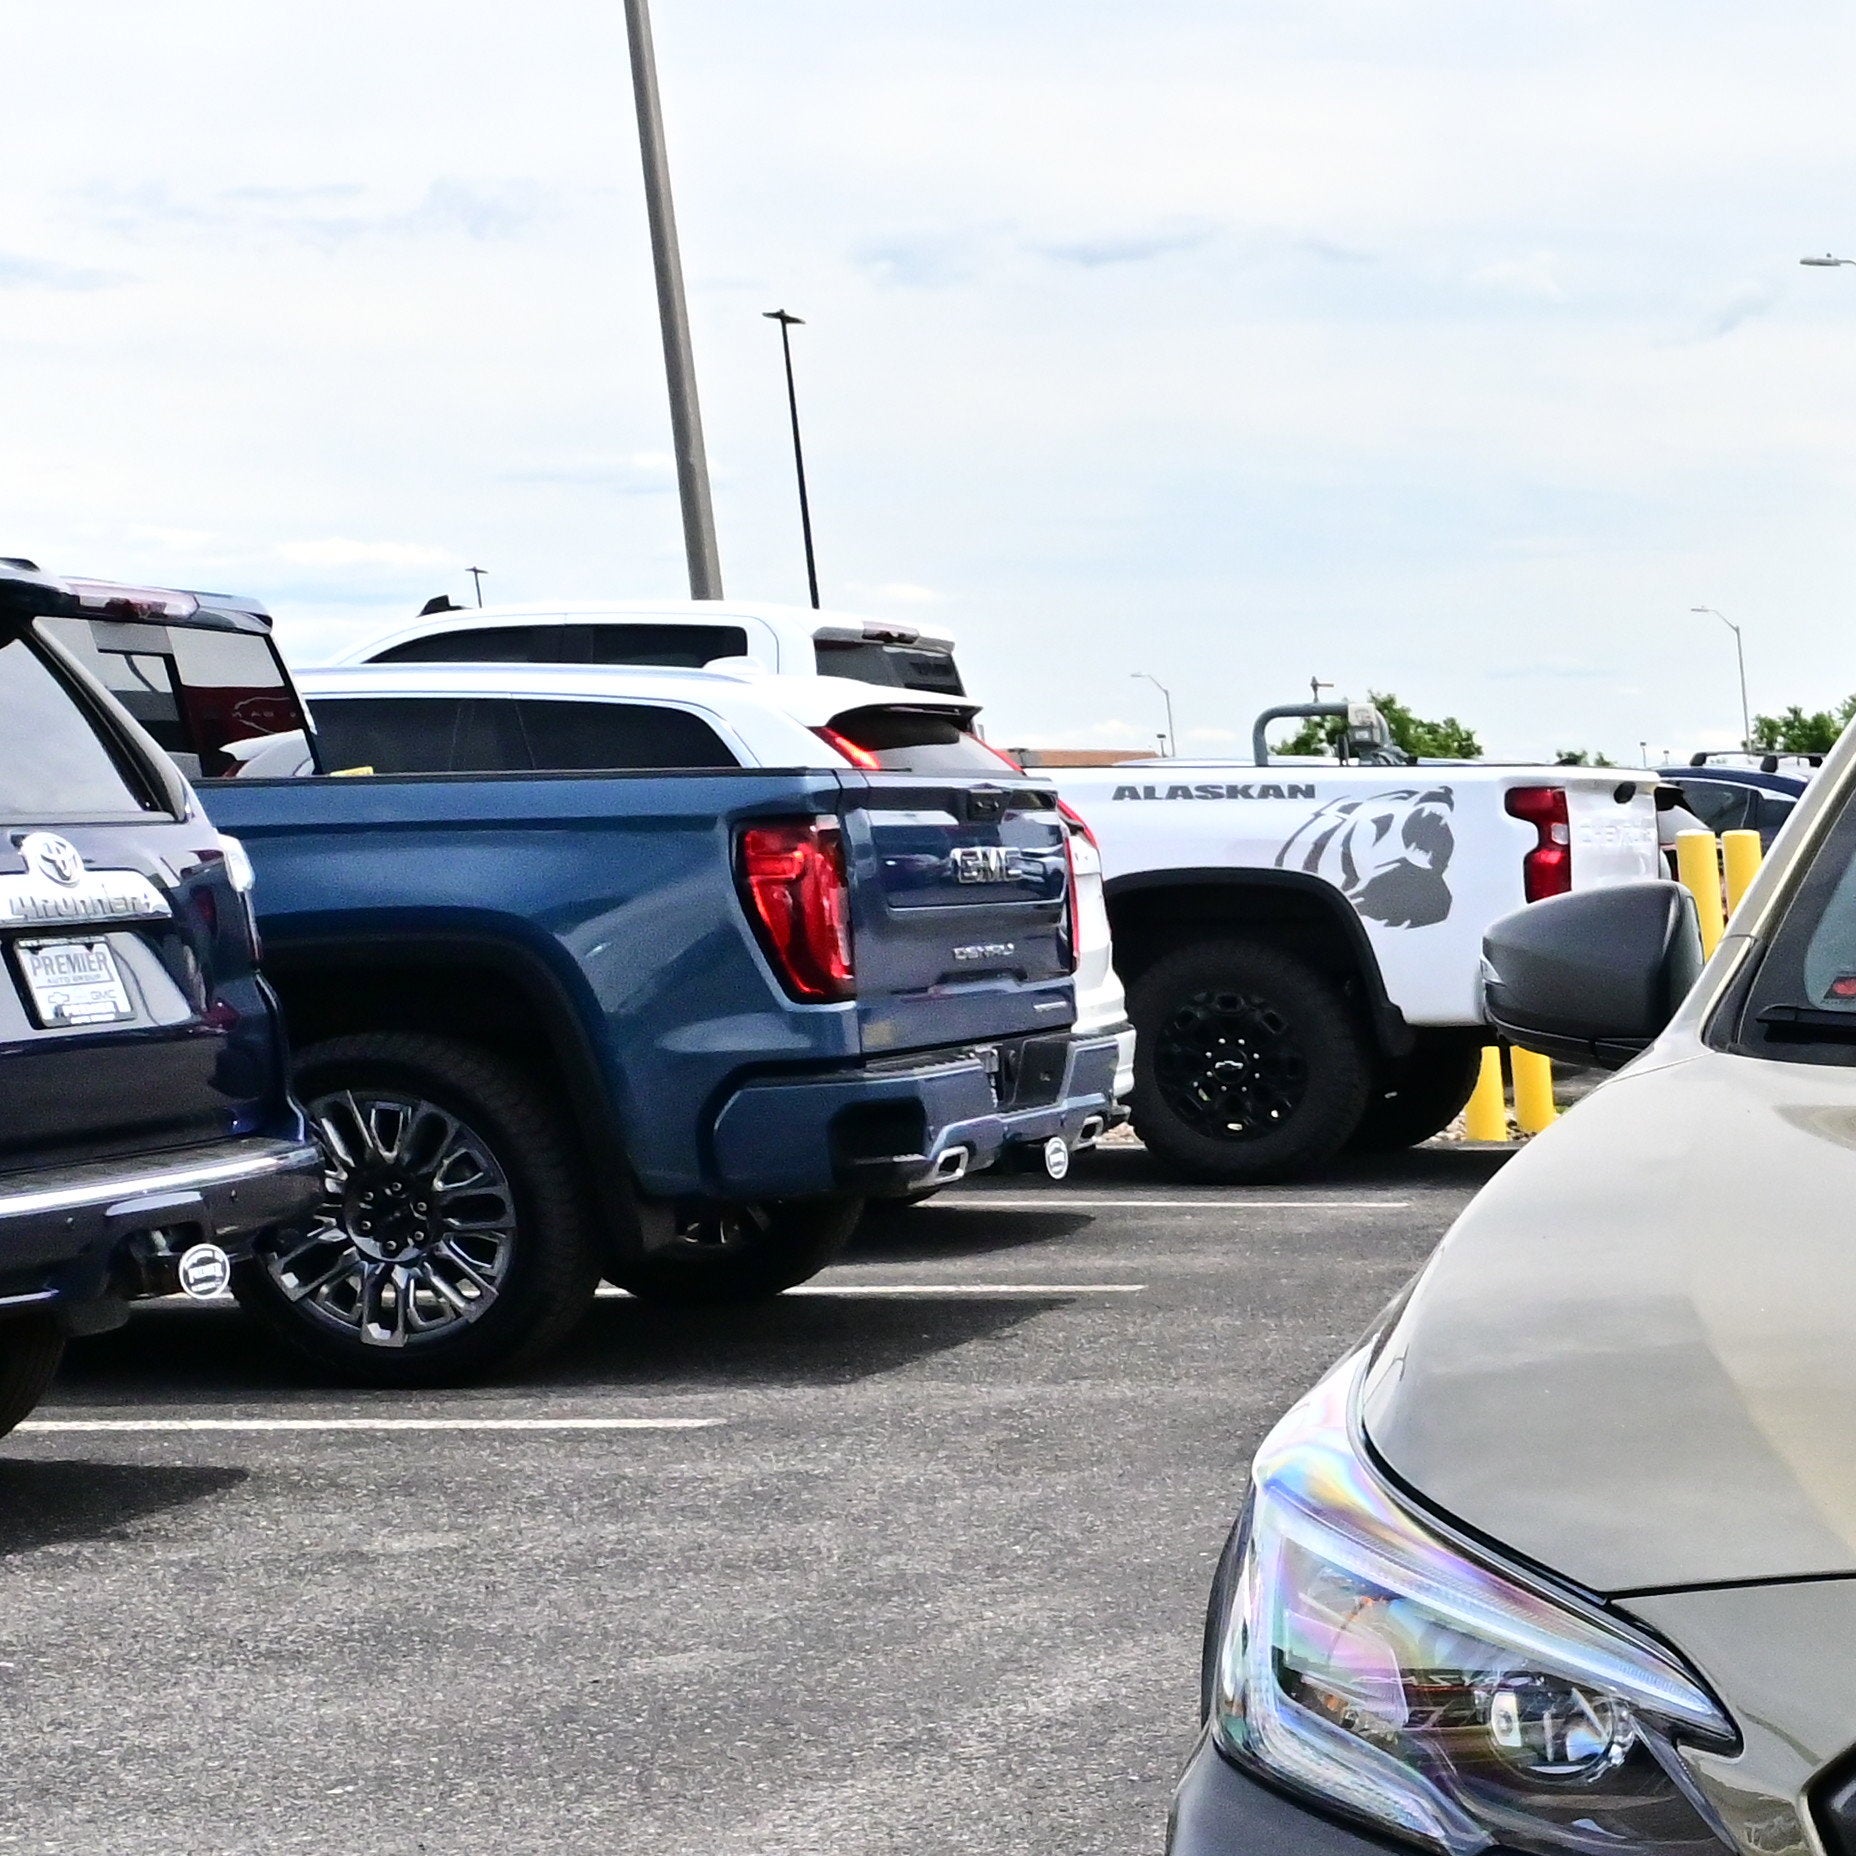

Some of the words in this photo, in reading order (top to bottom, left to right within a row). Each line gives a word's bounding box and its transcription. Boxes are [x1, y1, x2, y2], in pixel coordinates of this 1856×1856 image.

[1112, 784, 1316, 801] ALASKAN
[951, 847, 1022, 884] GMC
[30, 951, 108, 977] PREMIER
